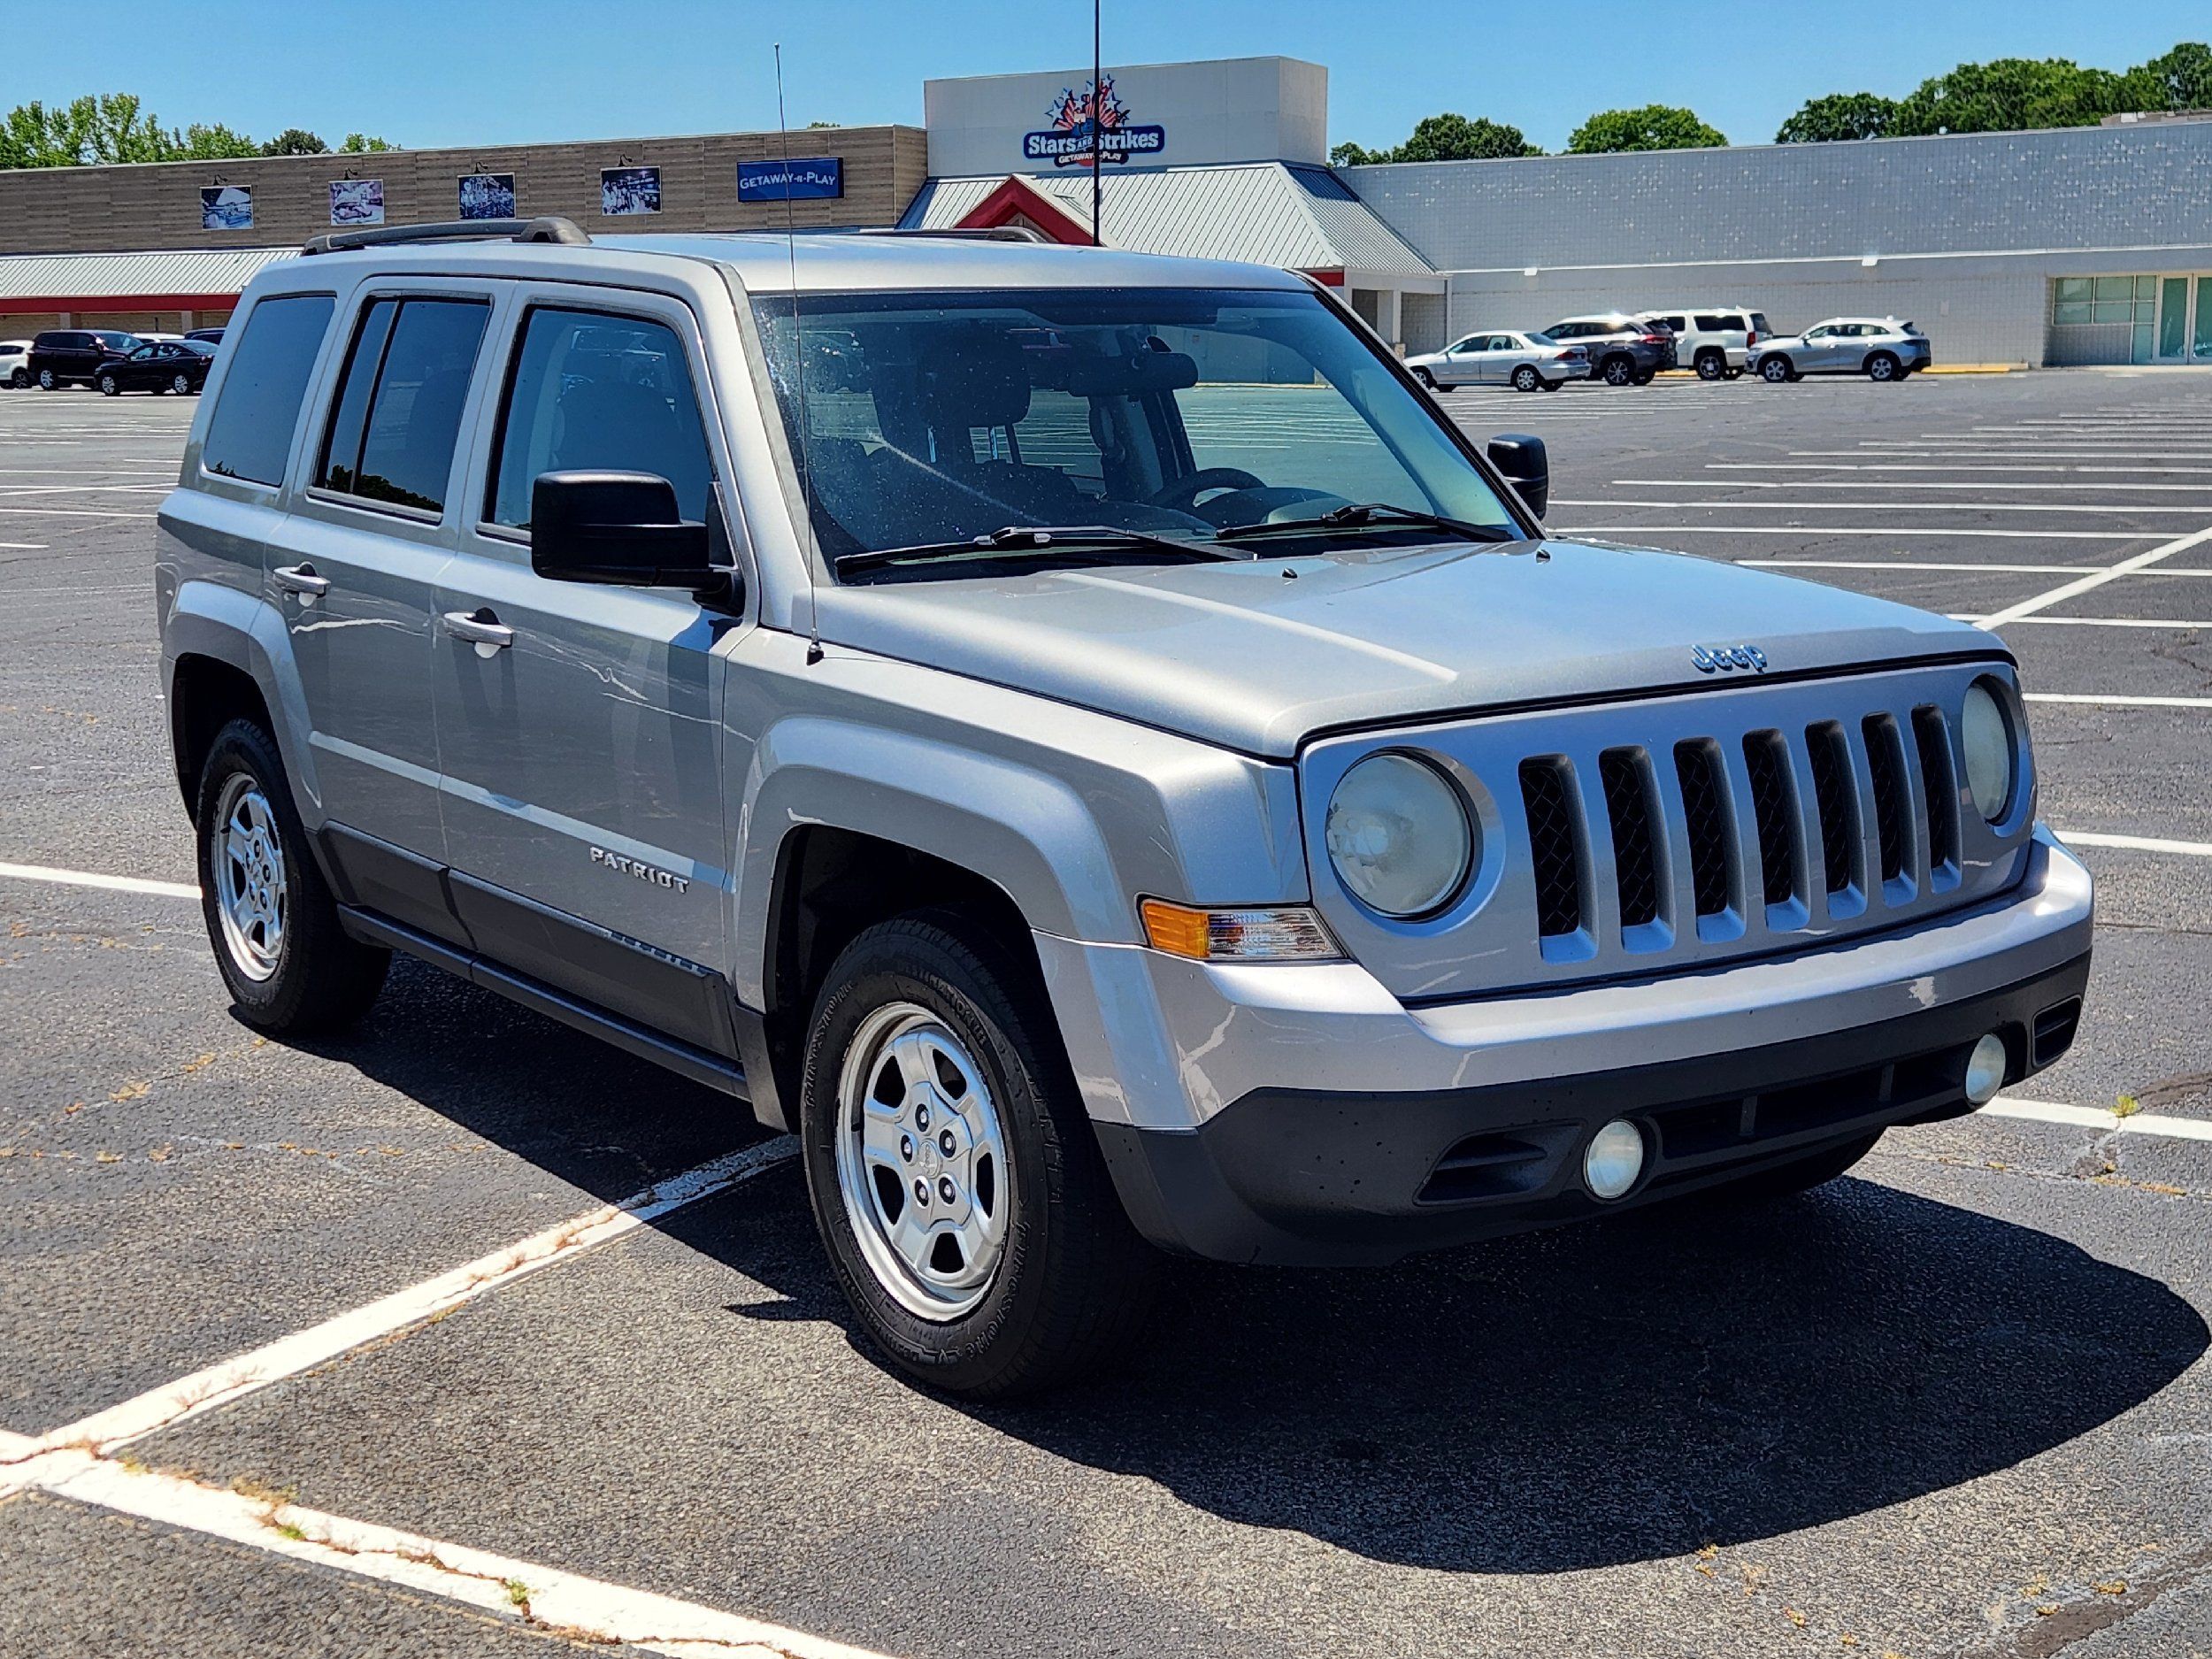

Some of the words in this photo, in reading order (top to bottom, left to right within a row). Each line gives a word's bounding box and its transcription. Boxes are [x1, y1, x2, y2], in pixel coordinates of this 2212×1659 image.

[1028, 135, 1077, 155] Stars
[1078, 135, 1094, 149] AND
[1691, 645, 1768, 673] Jeep
[589, 846, 690, 894] PATRIOT
